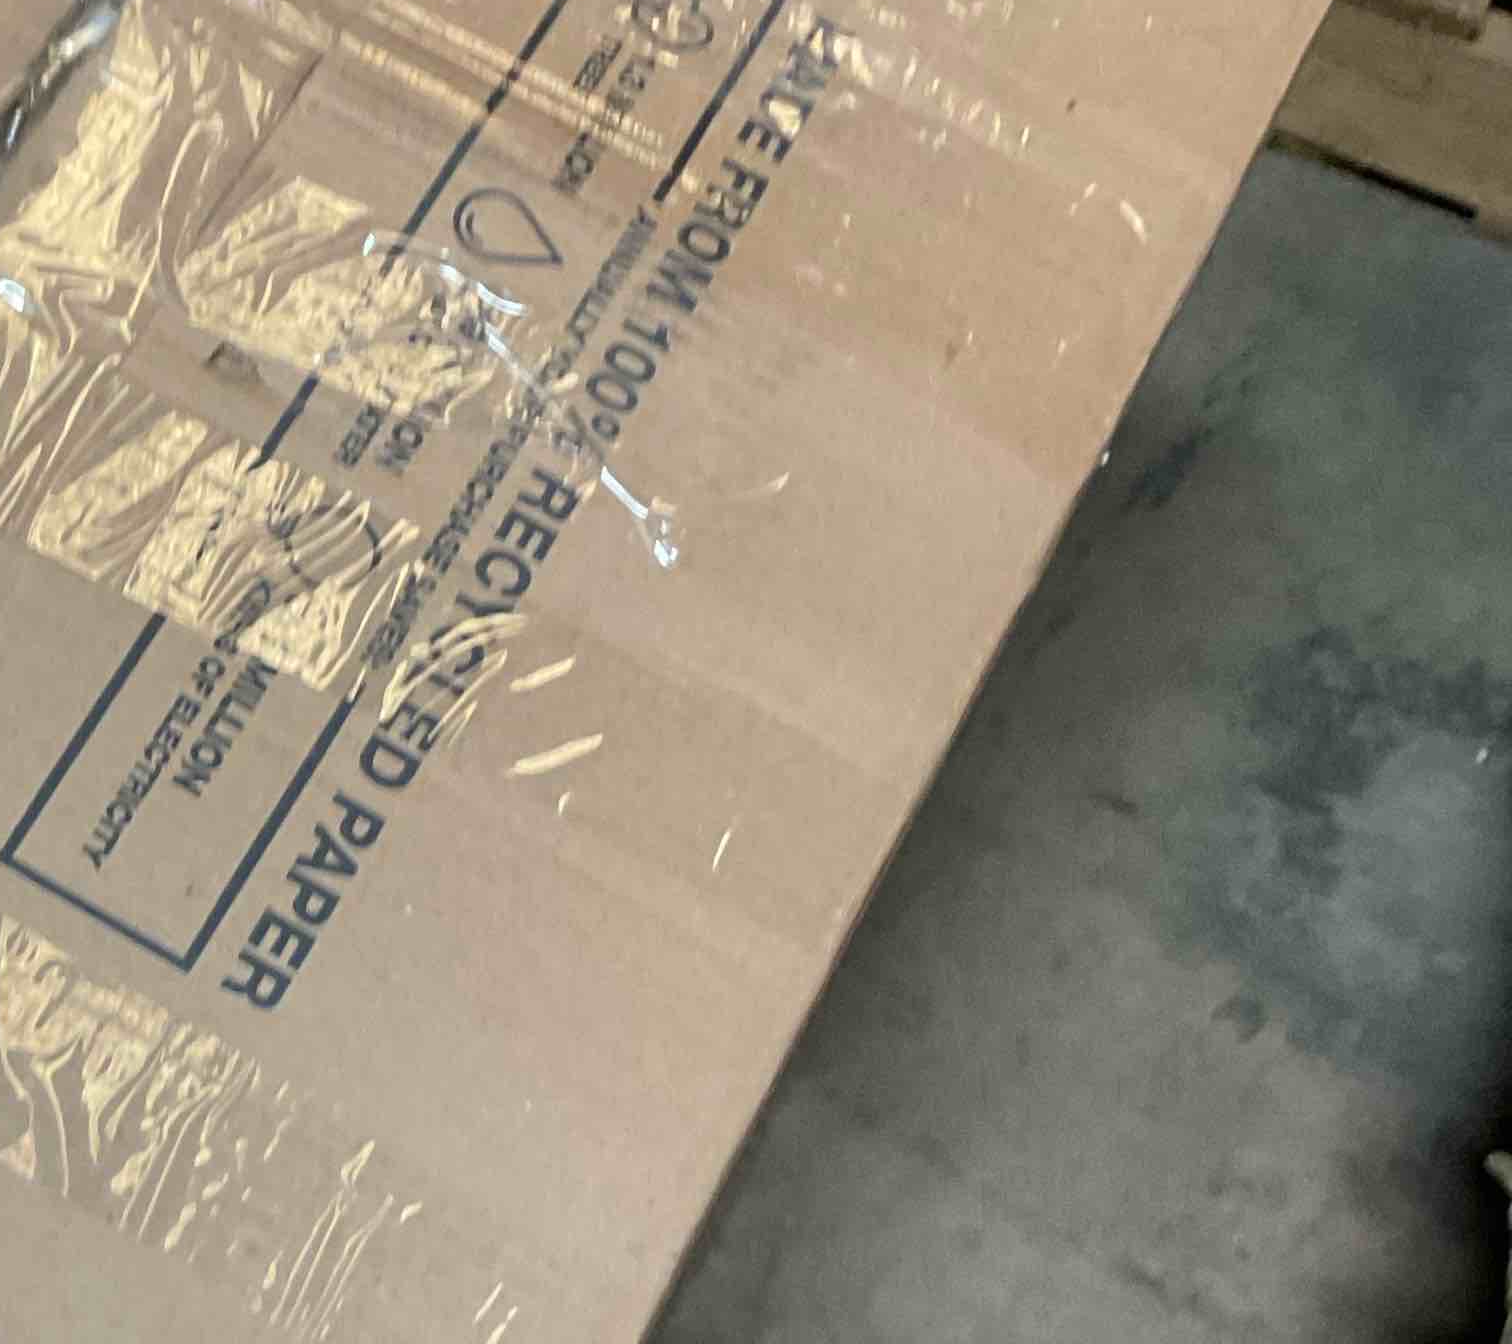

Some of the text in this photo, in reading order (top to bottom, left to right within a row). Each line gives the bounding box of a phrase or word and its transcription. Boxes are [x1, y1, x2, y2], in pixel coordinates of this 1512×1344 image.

[548, 84, 636, 201] MLION
[564, 32, 623, 108] TREE
[557, 206, 661, 351] ANNUALLY
[638, 154, 773, 324] FROM
[331, 382, 400, 472] ATER
[547, 305, 682, 474] 100%
[419, 421, 529, 576] PURCHASE
[183, 649, 229, 698] OF
[348, 464, 587, 801] RECYCLED
[73, 689, 202, 874] ELECTRICITY
[168, 651, 280, 801] MILLION
[216, 789, 389, 1018] PAPER
